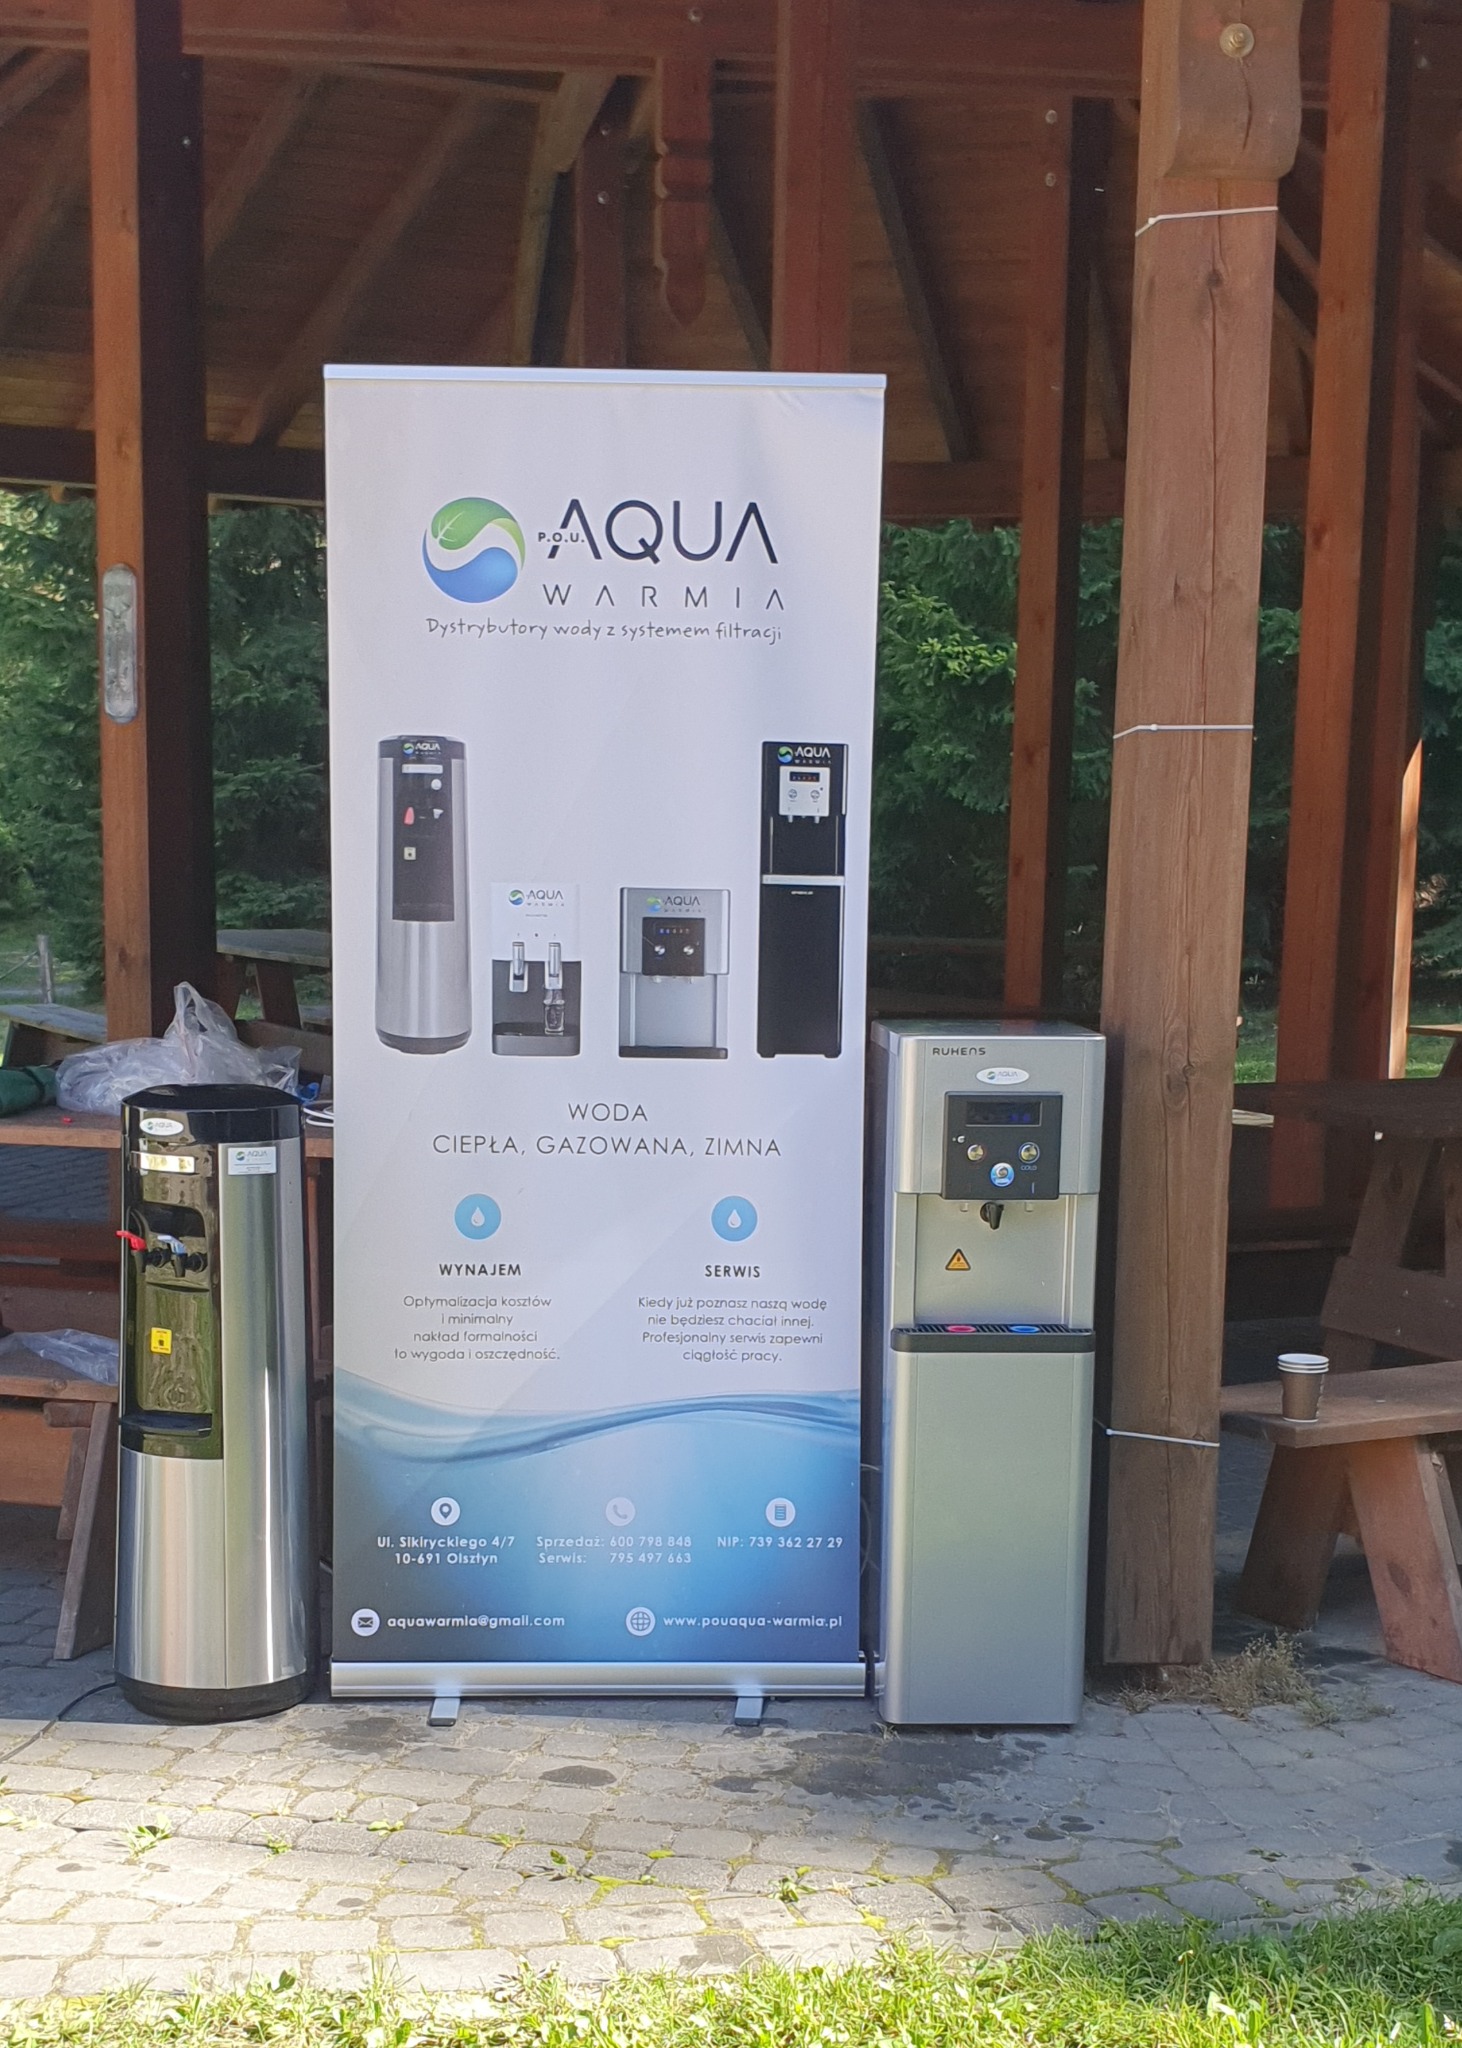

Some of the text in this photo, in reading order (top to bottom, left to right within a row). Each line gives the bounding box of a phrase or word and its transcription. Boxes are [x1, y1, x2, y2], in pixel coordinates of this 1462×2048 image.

[537, 498, 779, 565] P.O.U. AQUA
[542, 583, 785, 611] WARMIA
[426, 617, 782, 645] Dystrybutory wody z systemem filtracji
[795, 746, 831, 758] AQUA
[527, 889, 564, 900] AQUA
[663, 895, 700, 906] AQUA
[568, 1103, 649, 1122] WODA
[433, 1135, 782, 1157] CIEPŁA, GAZOWANA, ZIMNA
[439, 1263, 522, 1276] WYNAJEM
[705, 1265, 761, 1278] SERWIS
[403, 1295, 552, 1310] Optymalizacja kosztów
[638, 1297, 828, 1312] Kiedy już poznasz naszą wodę
[448, 1313, 514, 1326] minimalny
[648, 1314, 667, 1325] nie
[671, 1314, 725, 1327] będziesz
[781, 1315, 815, 1329] innej.
[414, 1330, 538, 1342] nakład formalności
[642, 1331, 823, 1346] Profesjonalny serwis zapewni
[394, 1348, 407, 1359] to
[411, 1348, 465, 1362] wygoda
[475, 1347, 561, 1361] oszczędność.
[683, 1348, 783, 1363] ciągłość pracy.
[399, 1535, 488, 1550] Sikiryckiego
[492, 1535, 515, 1548] 4/7
[536, 1535, 692, 1551] Sprzedaż: 600 798 848
[717, 1536, 843, 1549] NIP: 739 362 27 29
[395, 1552, 498, 1566] 10-691 Olsztyn
[538, 1552, 692, 1564] Serwis: 795 497 663
[387, 1614, 565, 1630] aquawarmia@gmail.com
[663, 1615, 843, 1630] www.pouaqua-warmia.pl
